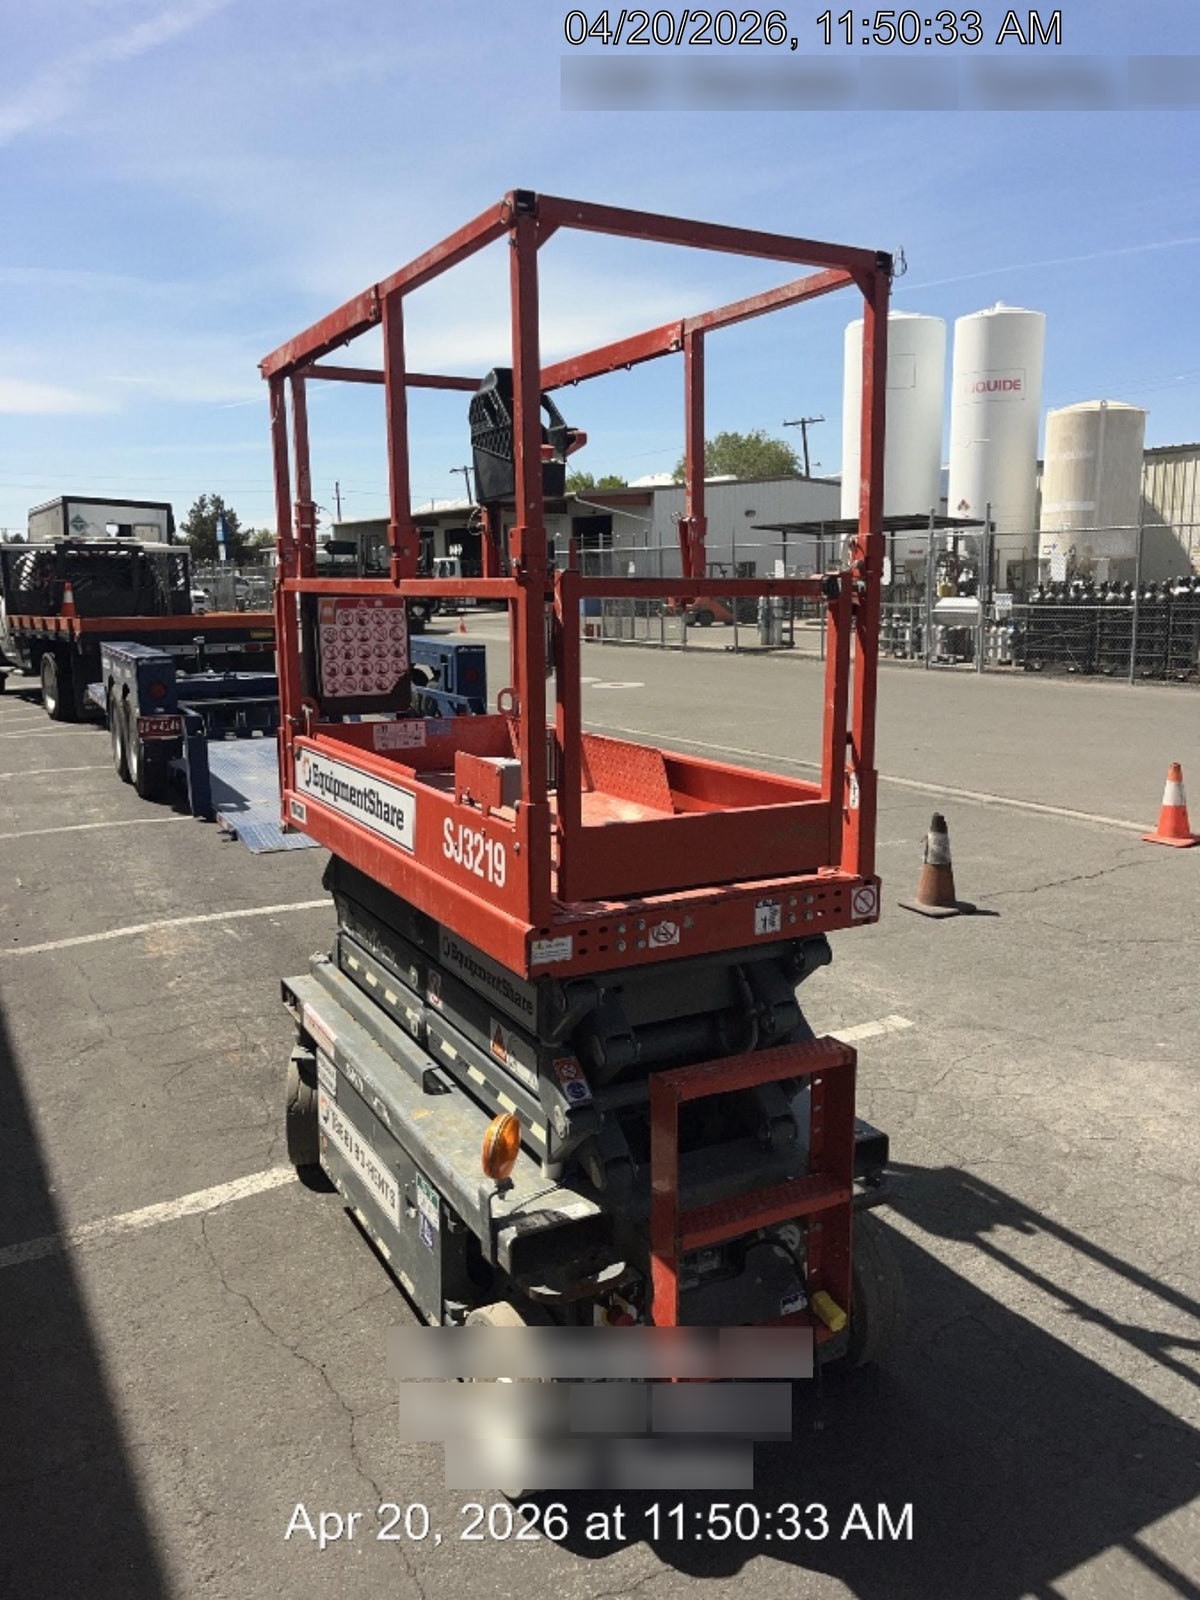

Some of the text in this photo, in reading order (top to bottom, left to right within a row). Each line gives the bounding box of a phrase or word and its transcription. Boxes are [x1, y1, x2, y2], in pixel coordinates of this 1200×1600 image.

[967, 378, 1022, 394] IQUIDE
[311, 761, 405, 831] EquipmentShare
[442, 816, 506, 888] SJ3219
[451, 941, 534, 1016] EquipmentShare
